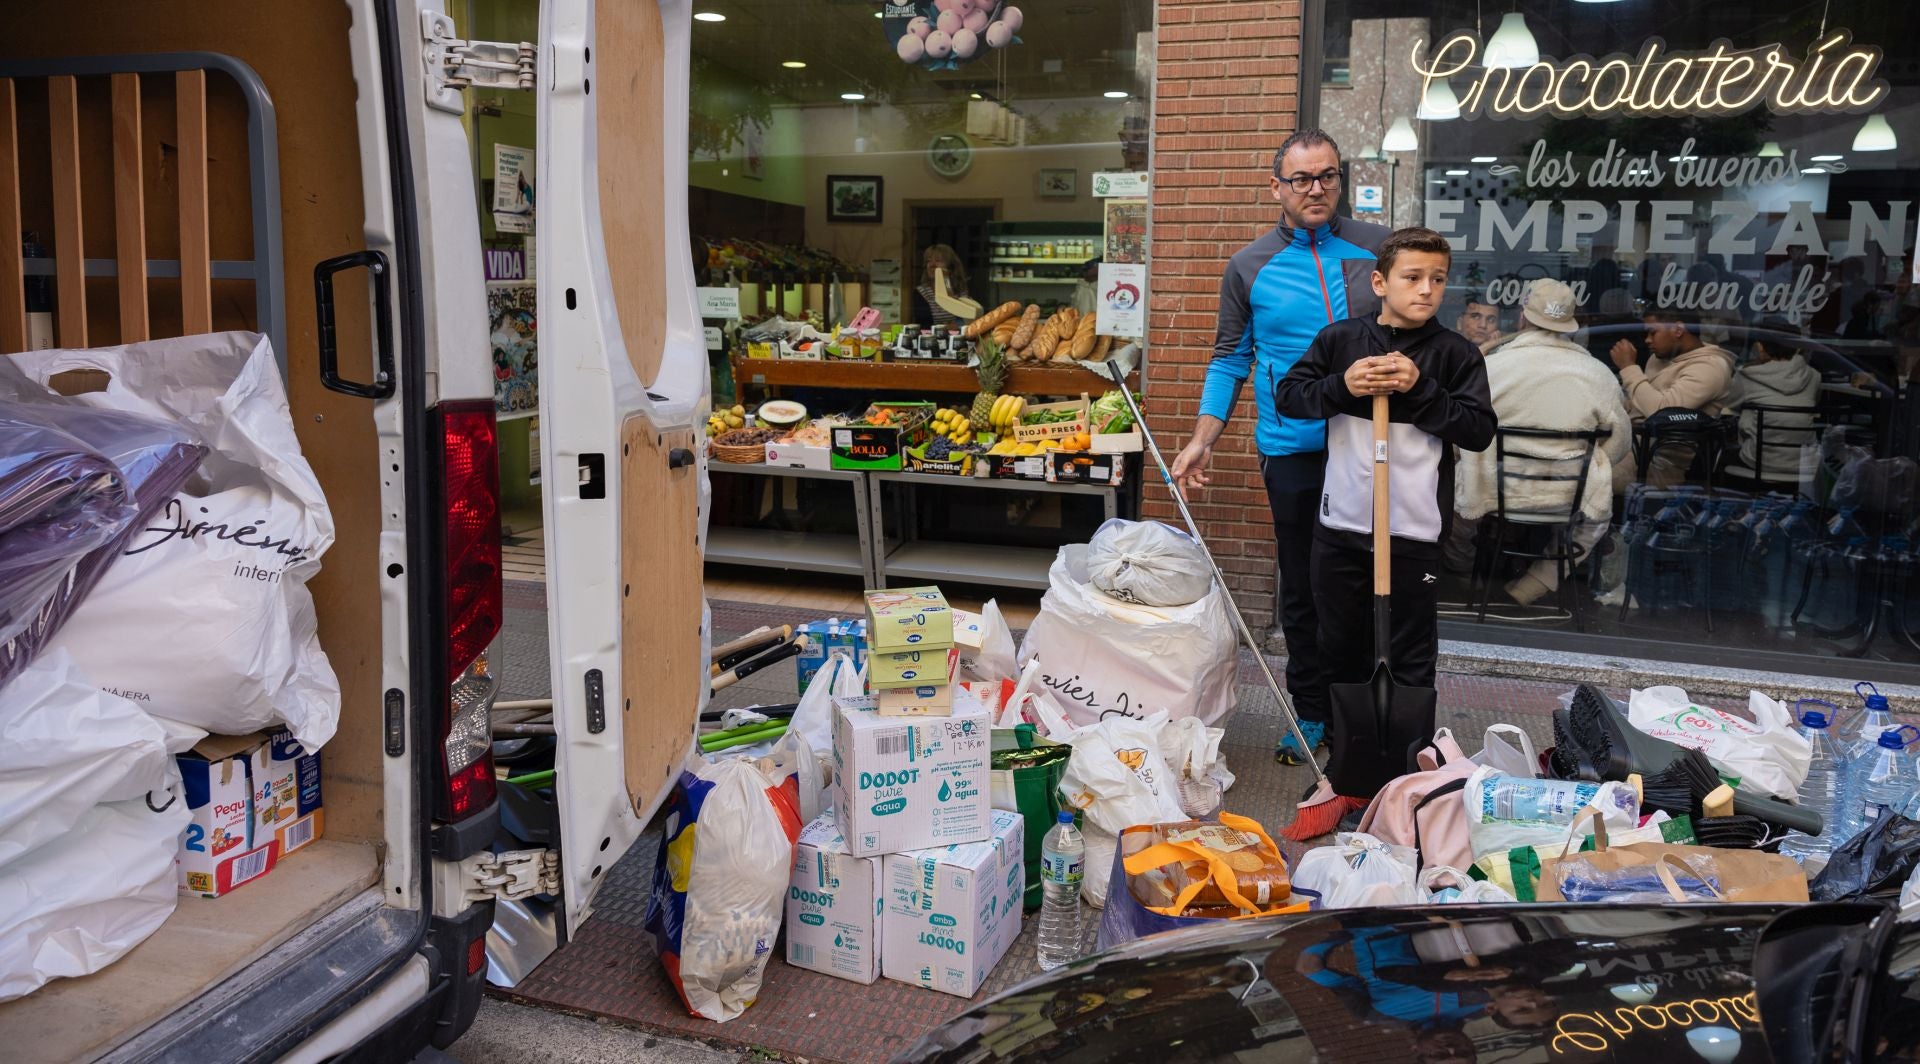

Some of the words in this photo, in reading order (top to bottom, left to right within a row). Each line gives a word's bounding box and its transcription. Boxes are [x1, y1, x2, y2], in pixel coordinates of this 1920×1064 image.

[885, 3, 916, 14] ESTUDIANTE
[1411, 35, 1881, 113] Chocolatería
[1526, 138, 1581, 188] los
[1587, 138, 1666, 188] días
[1673, 137, 1805, 188] buenos
[1424, 199, 1912, 257] EMPIEZAN
[487, 250, 523, 279] VIDA
[1656, 262, 1744, 310] buen
[1749, 264, 1832, 326] café
[1668, 413, 1698, 421] AMIRI
[850, 445, 887, 455] BOLLO
[233, 560, 286, 584] interi
[101, 687, 151, 702] NÁJERA
[1042, 674, 1101, 706] avier
[973, 761, 983, 769] piel
[859, 769, 920, 790] DODOT
[263, 781, 271, 799] 2
[873, 786, 904, 801] pure
[955, 789, 978, 800] agua
[213, 800, 246, 818] Pequ
[875, 803, 901, 813] aqua
[185, 823, 206, 853] 2
[790, 886, 835, 908] DODOT
[801, 902, 822, 914] pure
[802, 915, 822, 924] aqua
[933, 916, 954, 925] aqua
[918, 931, 966, 955] DODOT
